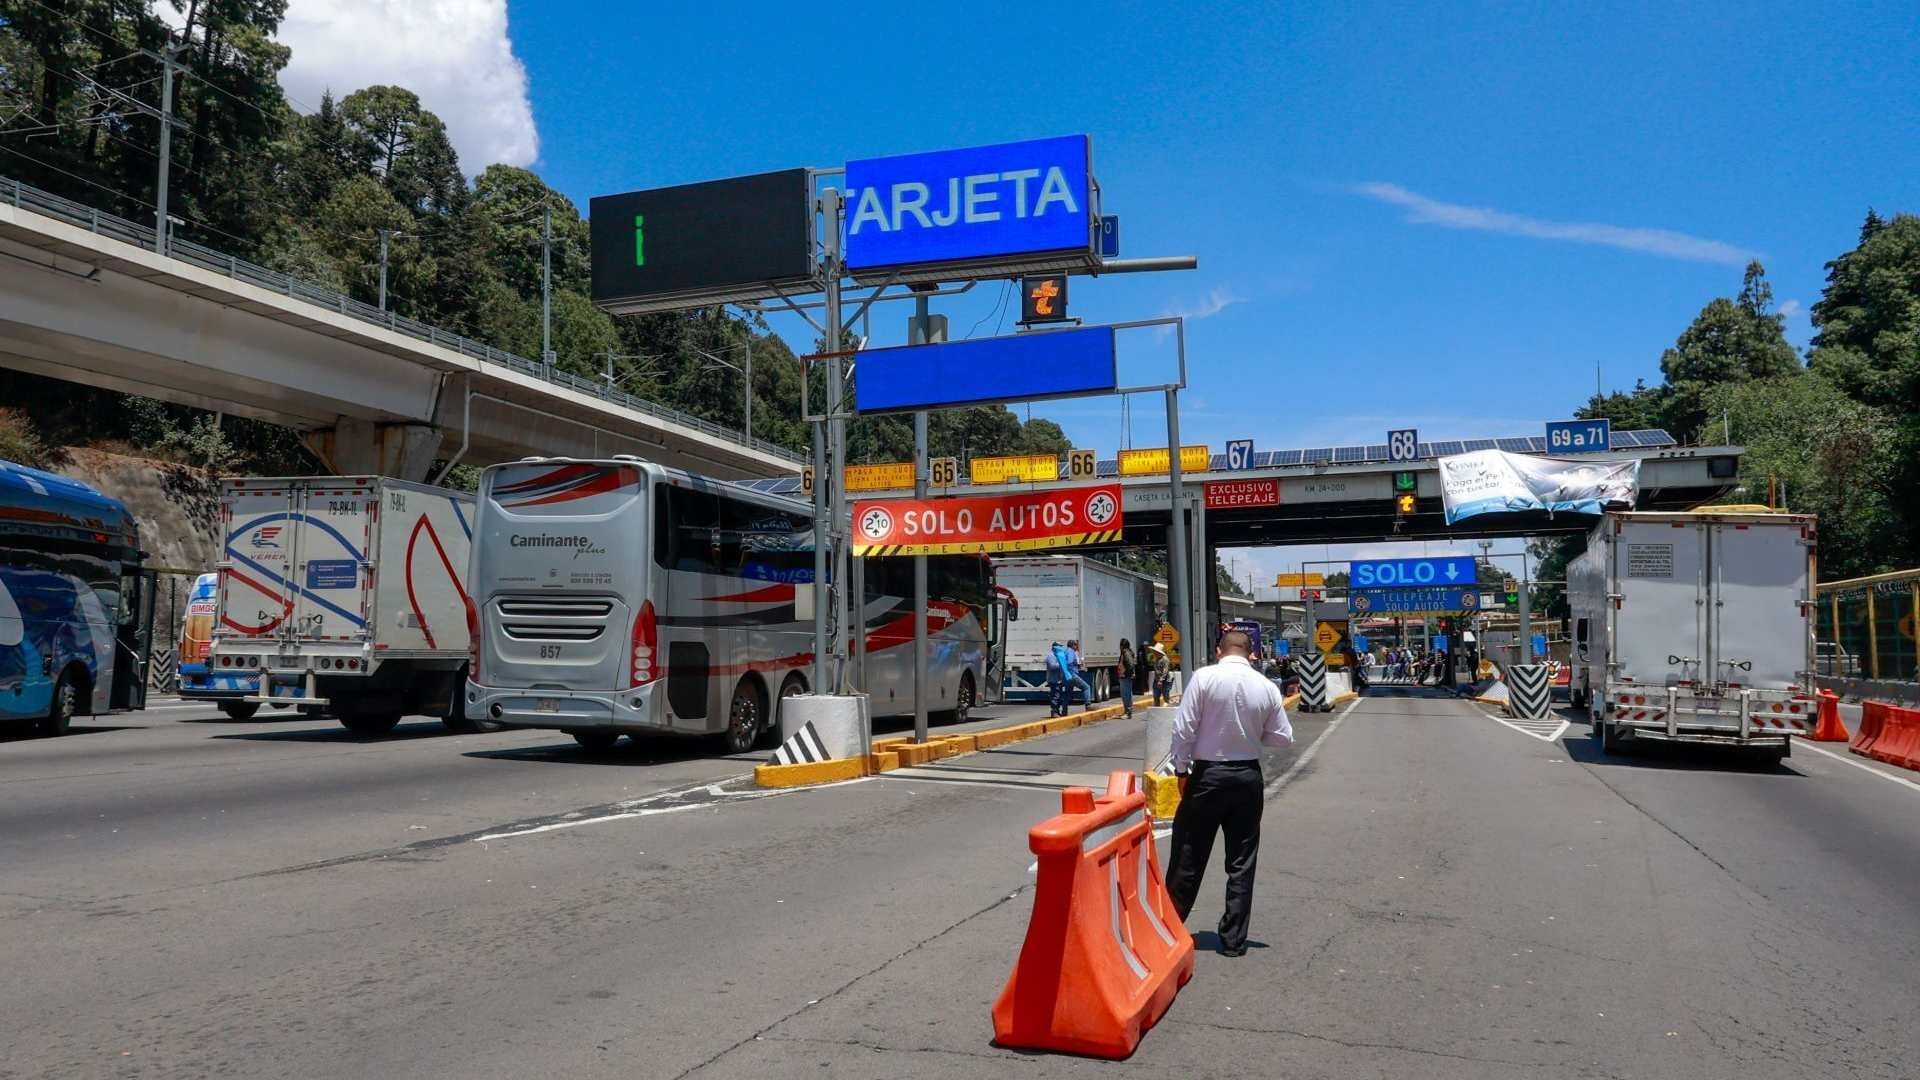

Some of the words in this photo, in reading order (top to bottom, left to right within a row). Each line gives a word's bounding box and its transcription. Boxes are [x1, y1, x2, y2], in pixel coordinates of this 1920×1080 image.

[1391, 431, 1416, 460] 68
[1551, 428, 1571, 447] 69
[1573, 433, 1585, 446] a
[1587, 426, 1604, 446] 71
[1071, 453, 1094, 476] 66
[1228, 441, 1251, 470] 67
[932, 461, 955, 483] 65
[1134, 493, 1158, 502] CASETA
[1210, 482, 1273, 495] EXCLUSIVO
[1208, 494, 1276, 506] TELEPEAJE
[903, 508, 973, 536] SOLO
[988, 499, 1075, 533] AUTOS
[510, 532, 588, 548] Caminante
[573, 542, 606, 560] plus
[1357, 562, 1436, 586] SOLO
[1381, 591, 1448, 602] TELEPEAJE
[1385, 602, 1410, 612] SOLO
[1413, 601, 1445, 611] AUTOS
[540, 645, 562, 659] 857
